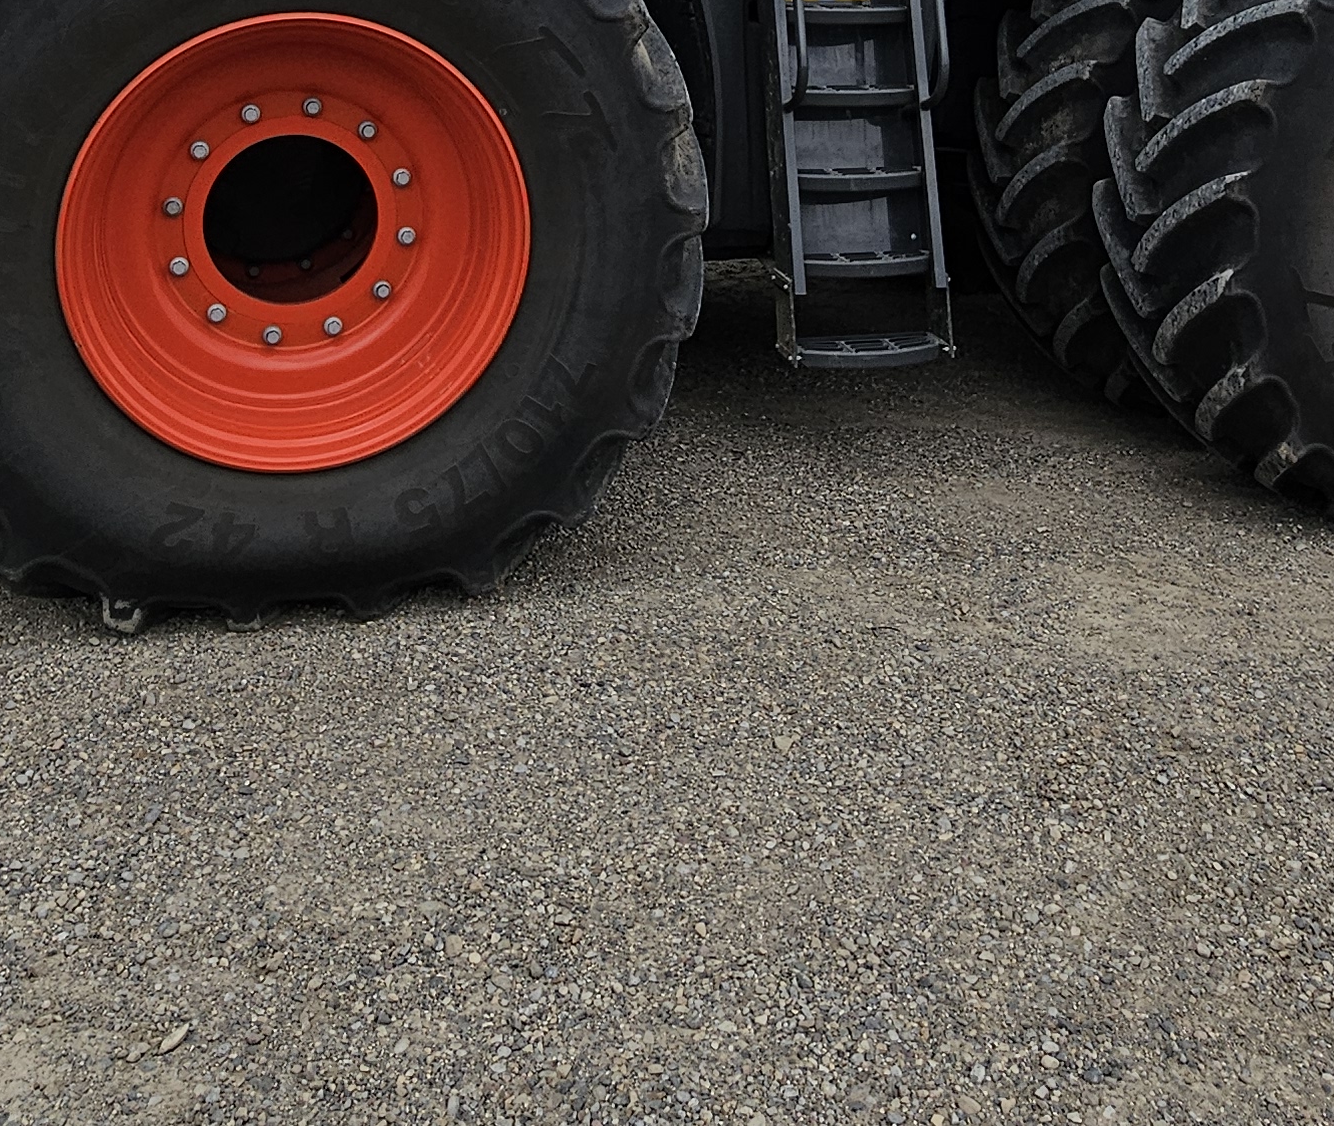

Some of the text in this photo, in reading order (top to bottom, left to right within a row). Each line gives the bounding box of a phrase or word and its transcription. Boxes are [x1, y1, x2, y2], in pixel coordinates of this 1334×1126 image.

[149, 355, 598, 558] 710/75 R 42
